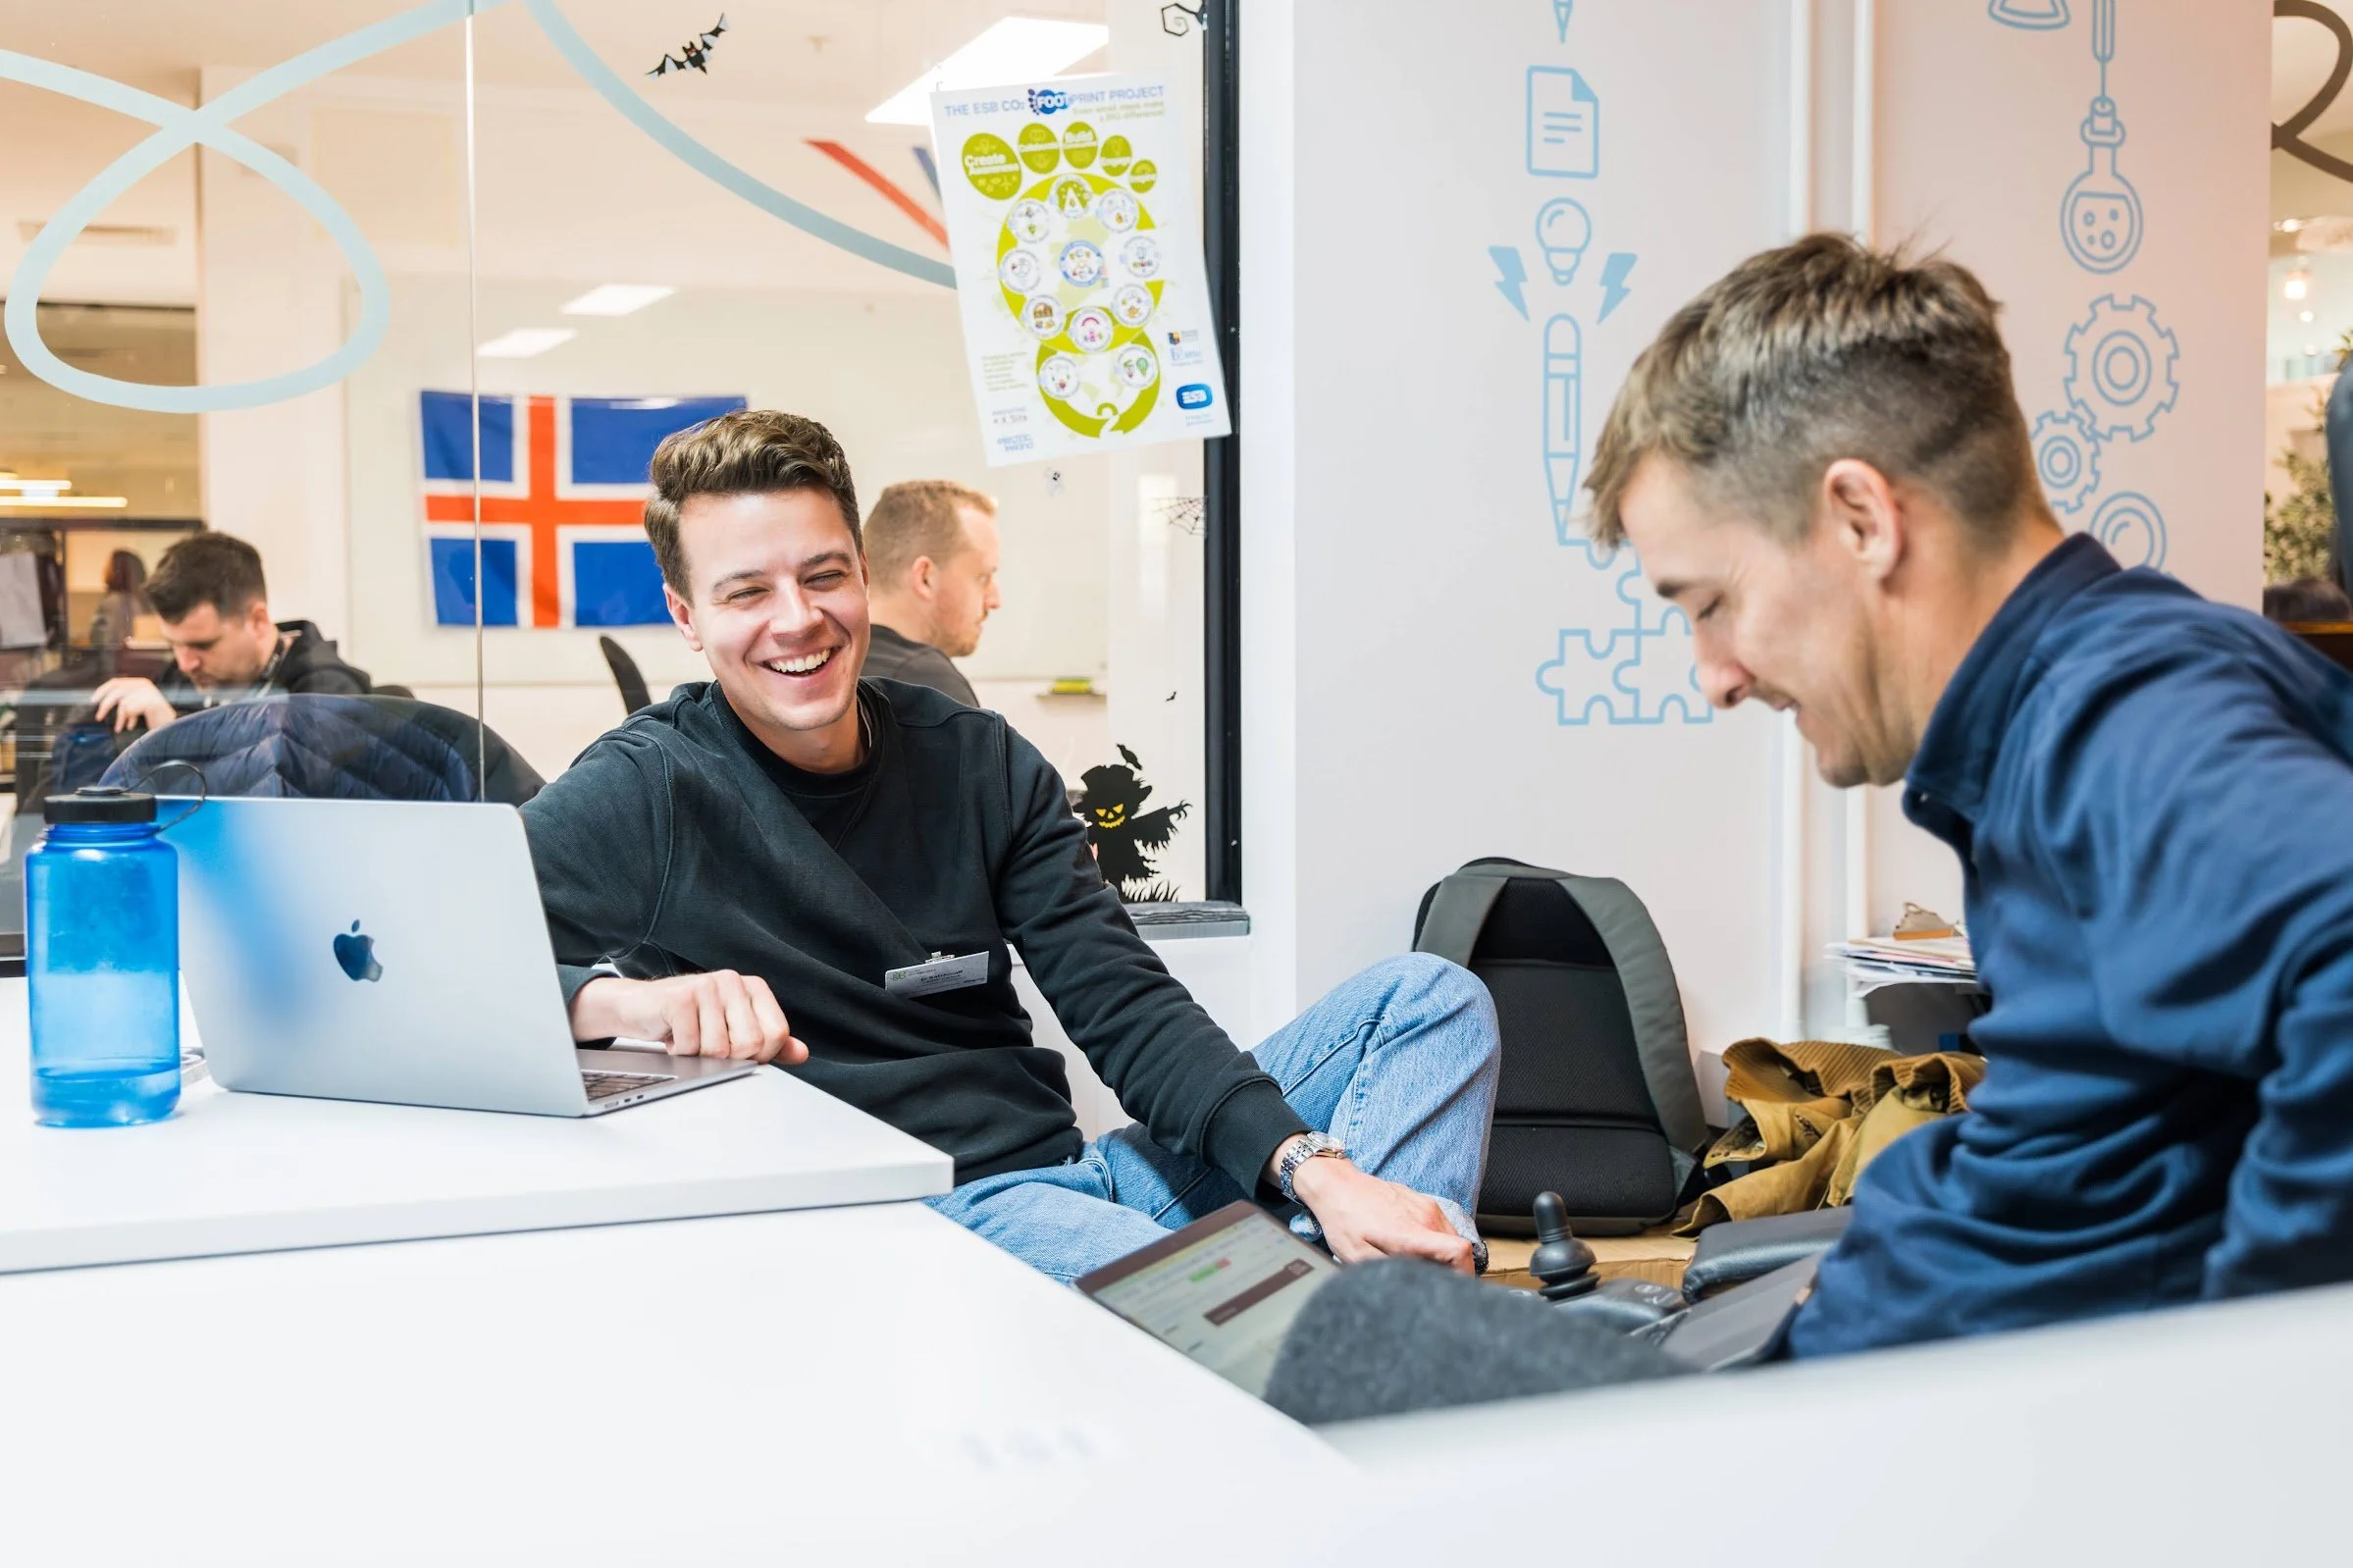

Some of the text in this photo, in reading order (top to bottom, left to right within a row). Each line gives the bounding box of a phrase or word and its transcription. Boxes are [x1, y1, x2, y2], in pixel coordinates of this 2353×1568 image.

[944, 103, 969, 117] THE
[972, 101, 998, 115] ESB
[1110, 85, 1164, 100] PROJECT
[965, 154, 1007, 167] Create
